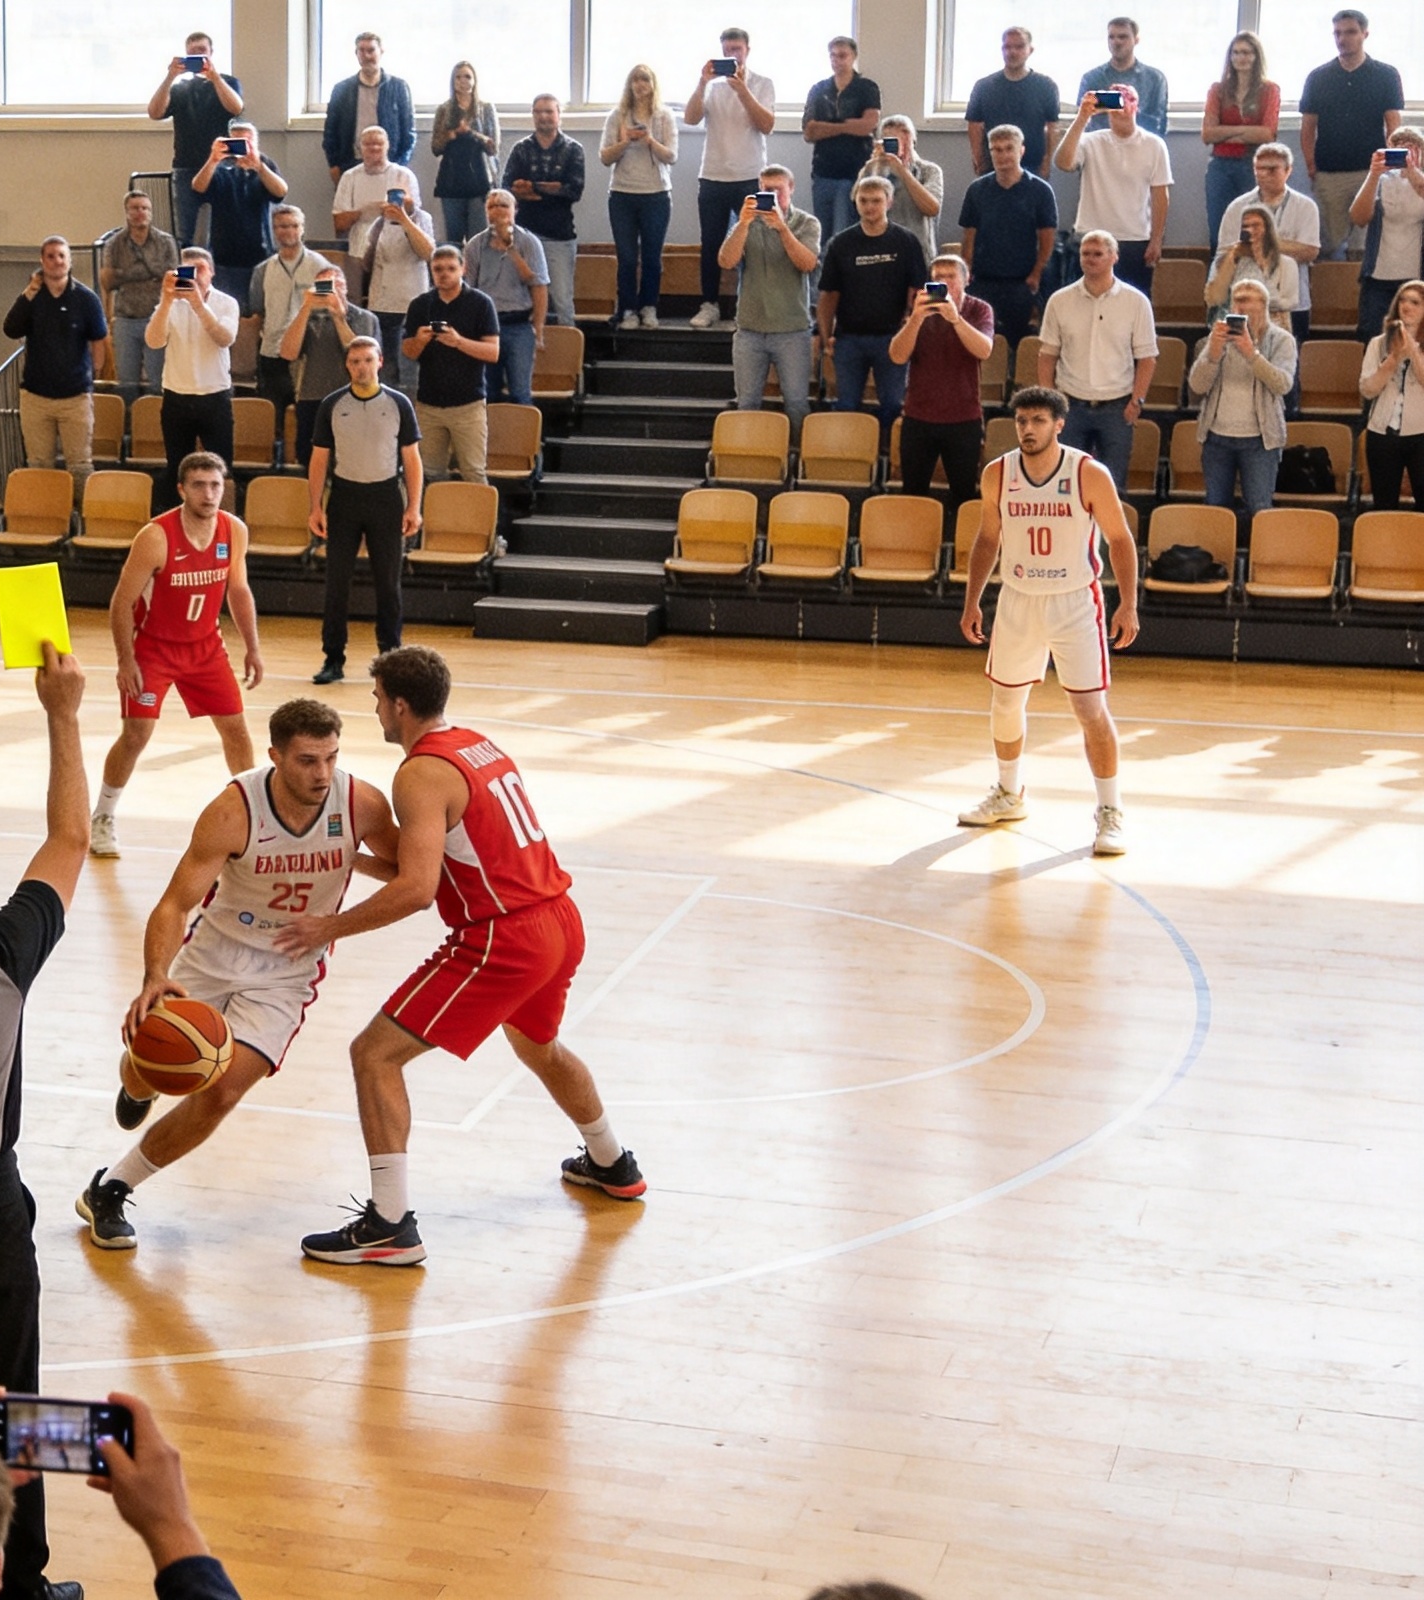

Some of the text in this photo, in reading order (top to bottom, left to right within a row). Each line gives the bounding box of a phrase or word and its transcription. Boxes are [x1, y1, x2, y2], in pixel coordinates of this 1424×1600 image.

[1027, 526, 1052, 556] 10
[186, 593, 206, 622] 0
[487, 771, 544, 849] 10
[267, 882, 314, 913] 25
